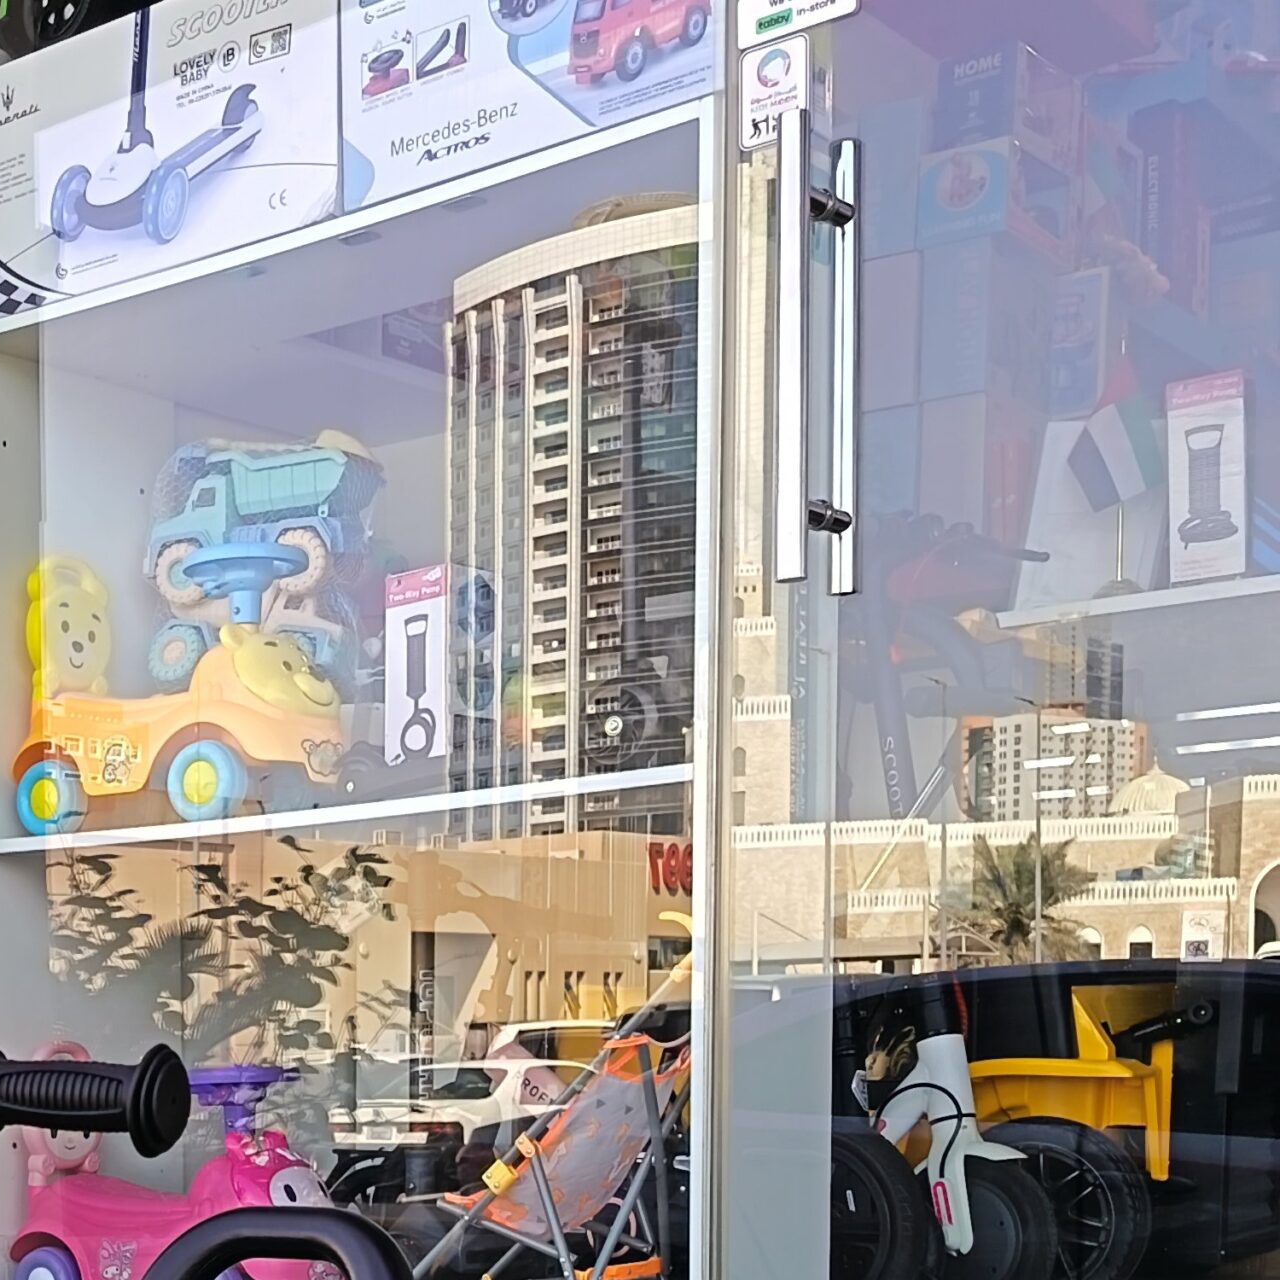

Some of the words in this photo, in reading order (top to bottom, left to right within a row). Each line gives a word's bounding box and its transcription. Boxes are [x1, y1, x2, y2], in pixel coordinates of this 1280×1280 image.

[759, 13, 791, 30] tabby
[173, 49, 217, 77] LOVELY
[180, 66, 211, 87] BABY
[954, 53, 1003, 79] HOME
[390, 102, 519, 158] Mercedes-Benz
[1147, 155, 1160, 231] ELECTRONIC
[883, 736, 904, 816] SCOOT
